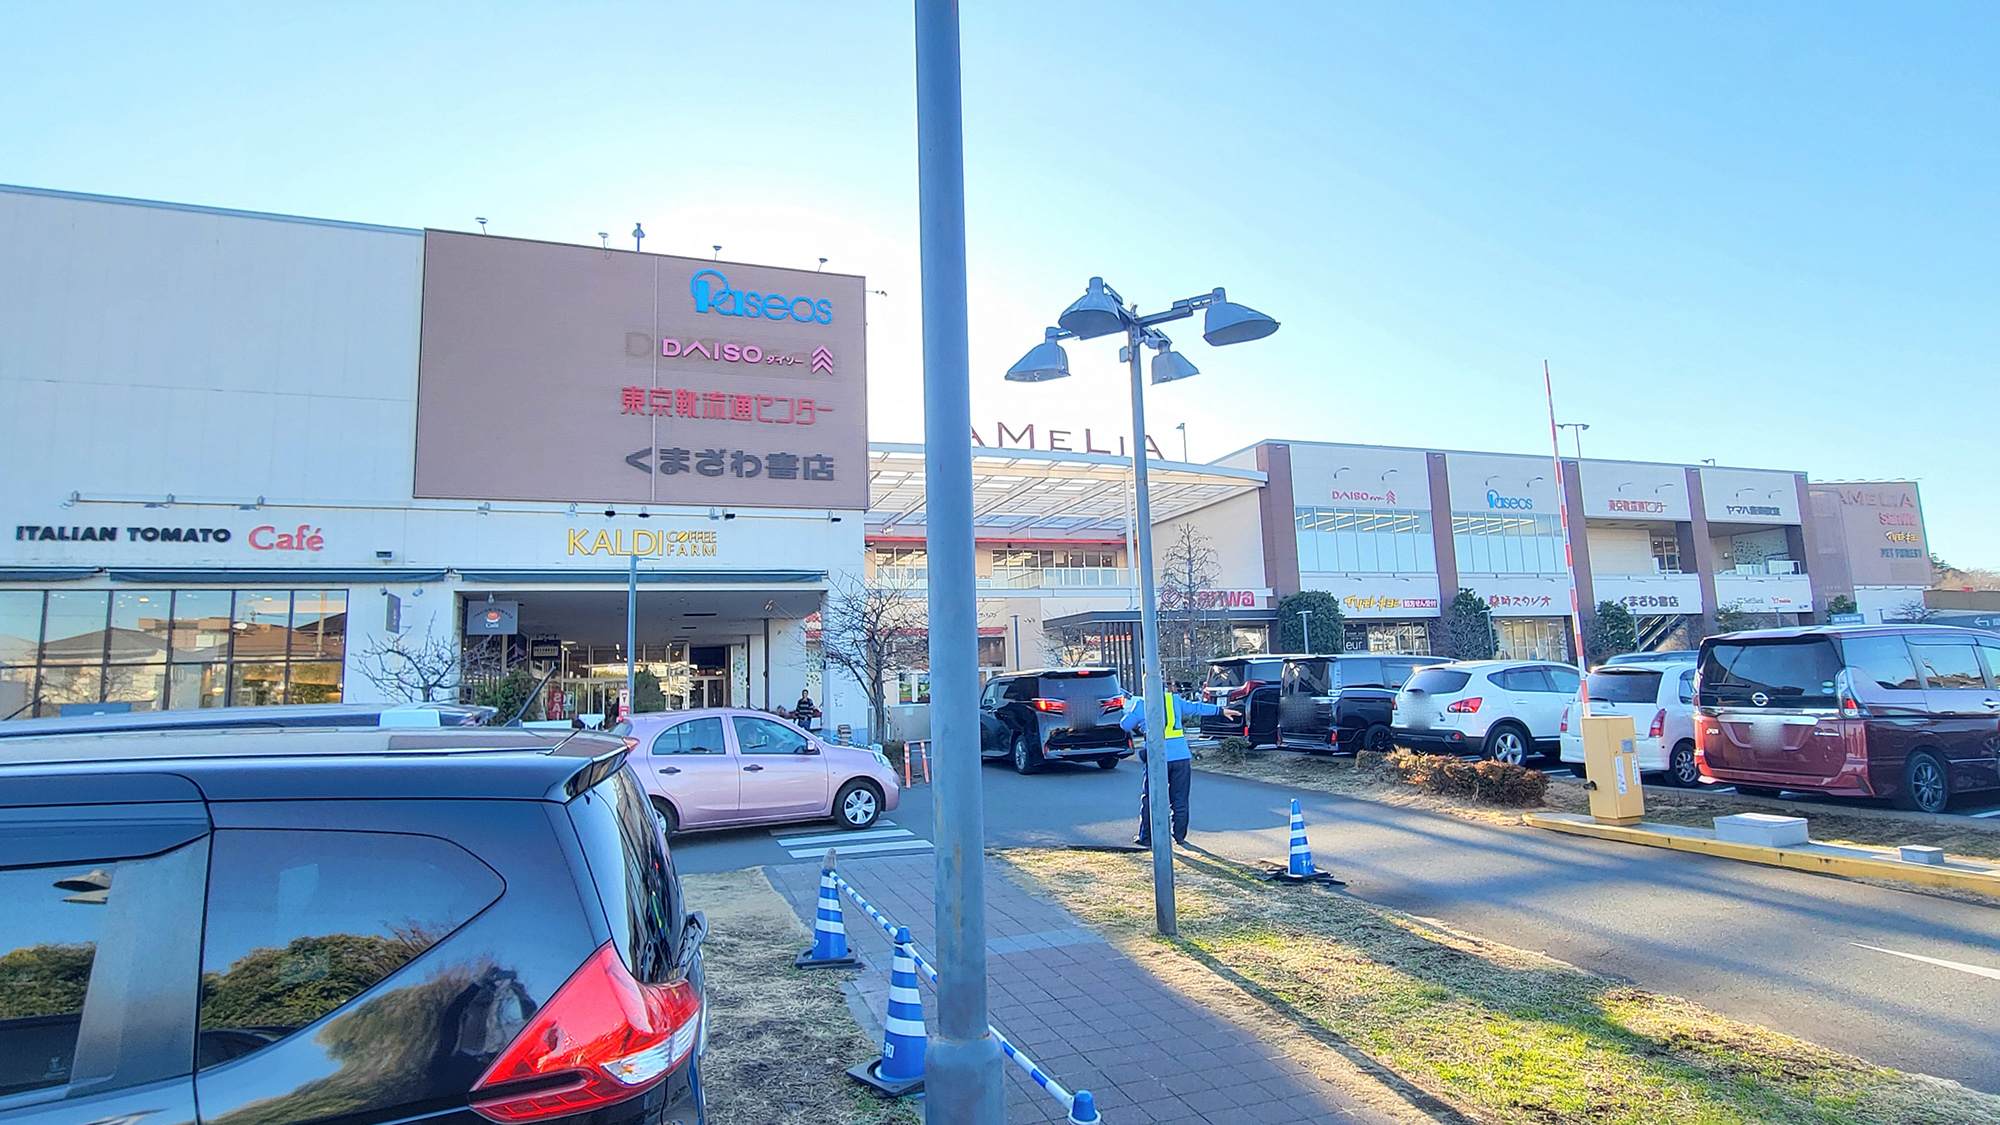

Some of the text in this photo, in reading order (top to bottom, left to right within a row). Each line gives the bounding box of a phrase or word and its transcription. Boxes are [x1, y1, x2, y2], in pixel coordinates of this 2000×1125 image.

[690, 269, 833, 324] Paseos
[662, 338, 763, 363] DAISO
[621, 385, 833, 425] 東京靴流通センター
[625, 447, 835, 480] くまざわ書店
[1332, 491, 1369, 501] DAISO
[1486, 489, 1533, 510] Paseos
[16, 525, 325, 551] ITALIAN TOMATO Café
[568, 529, 664, 556] KALDI
[667, 543, 717, 557] FARM
